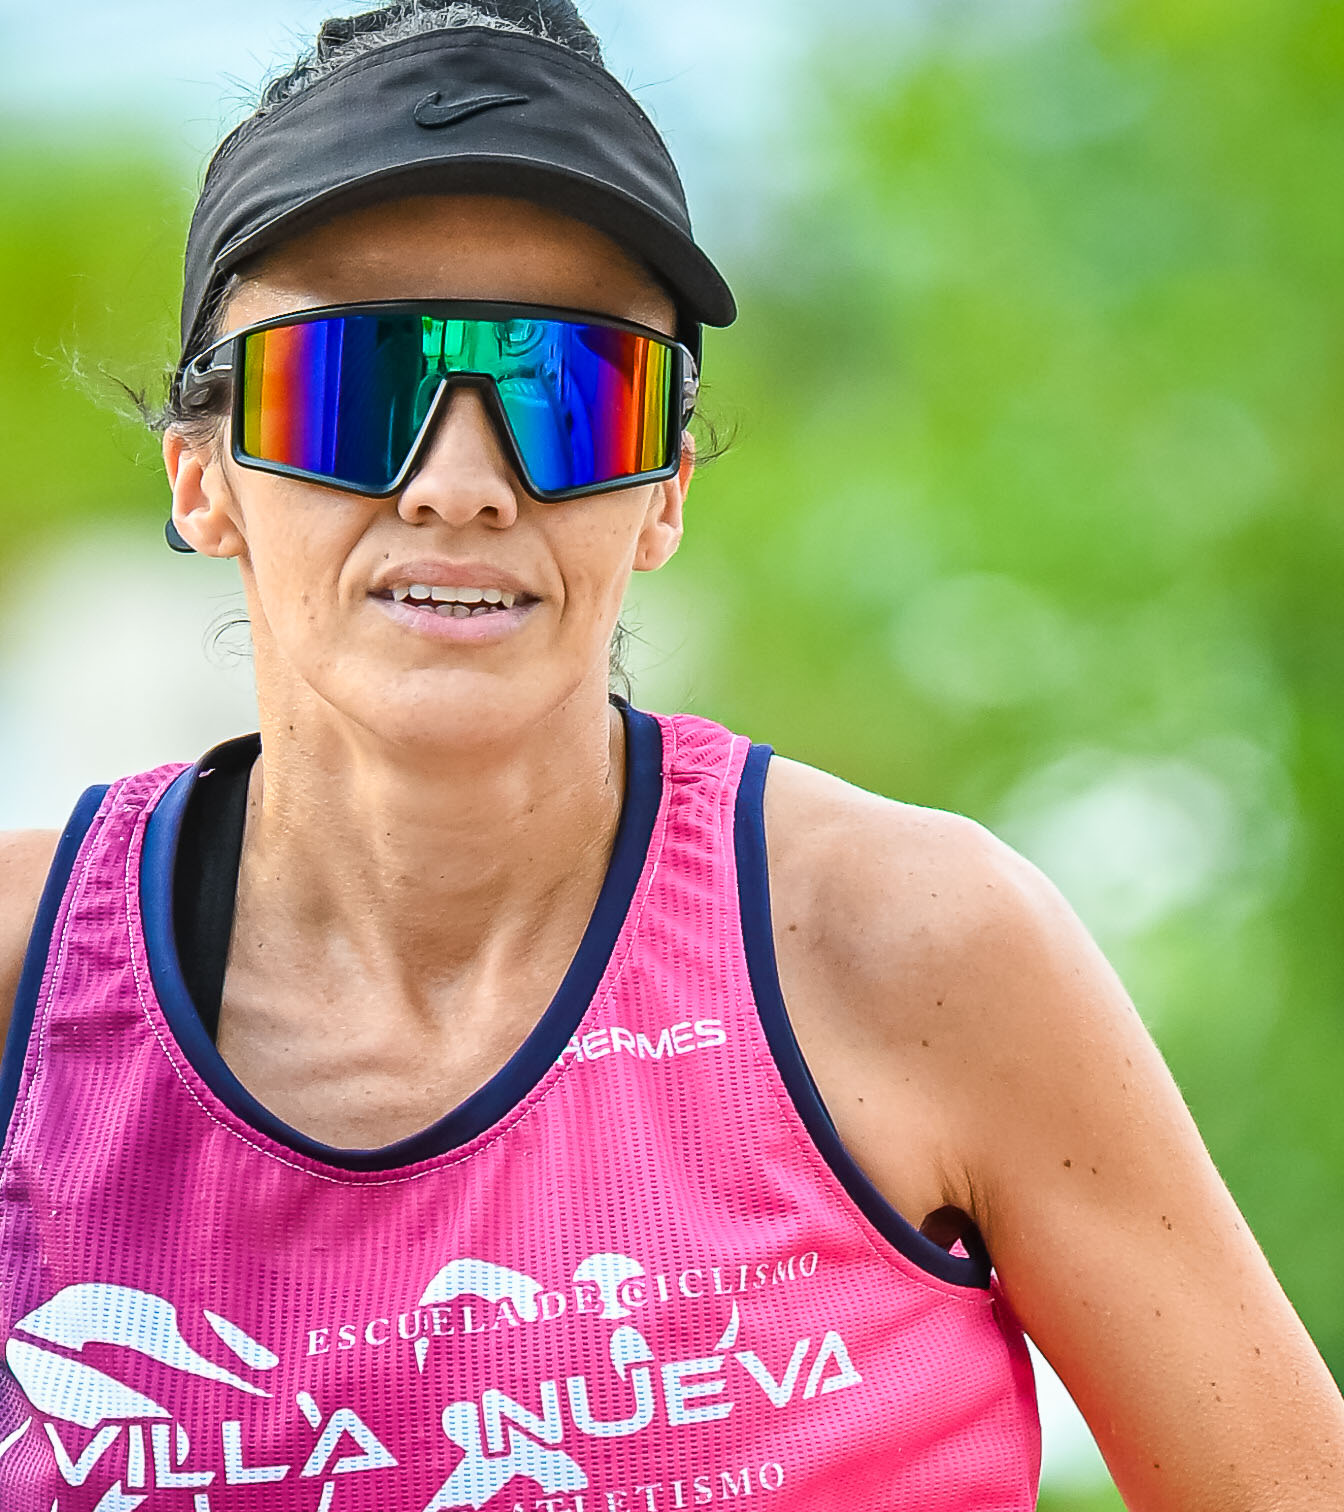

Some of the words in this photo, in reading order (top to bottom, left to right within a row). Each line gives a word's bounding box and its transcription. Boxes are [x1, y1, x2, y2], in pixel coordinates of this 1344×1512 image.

[556, 1019, 727, 1065] HERMES
[306, 1302, 522, 1356] ESCUELA
[539, 1285, 603, 1320] DE
[621, 1251, 819, 1309] CICLISMO
[43, 1408, 399, 1487] VILLA
[482, 1330, 863, 1456] NUEVA
